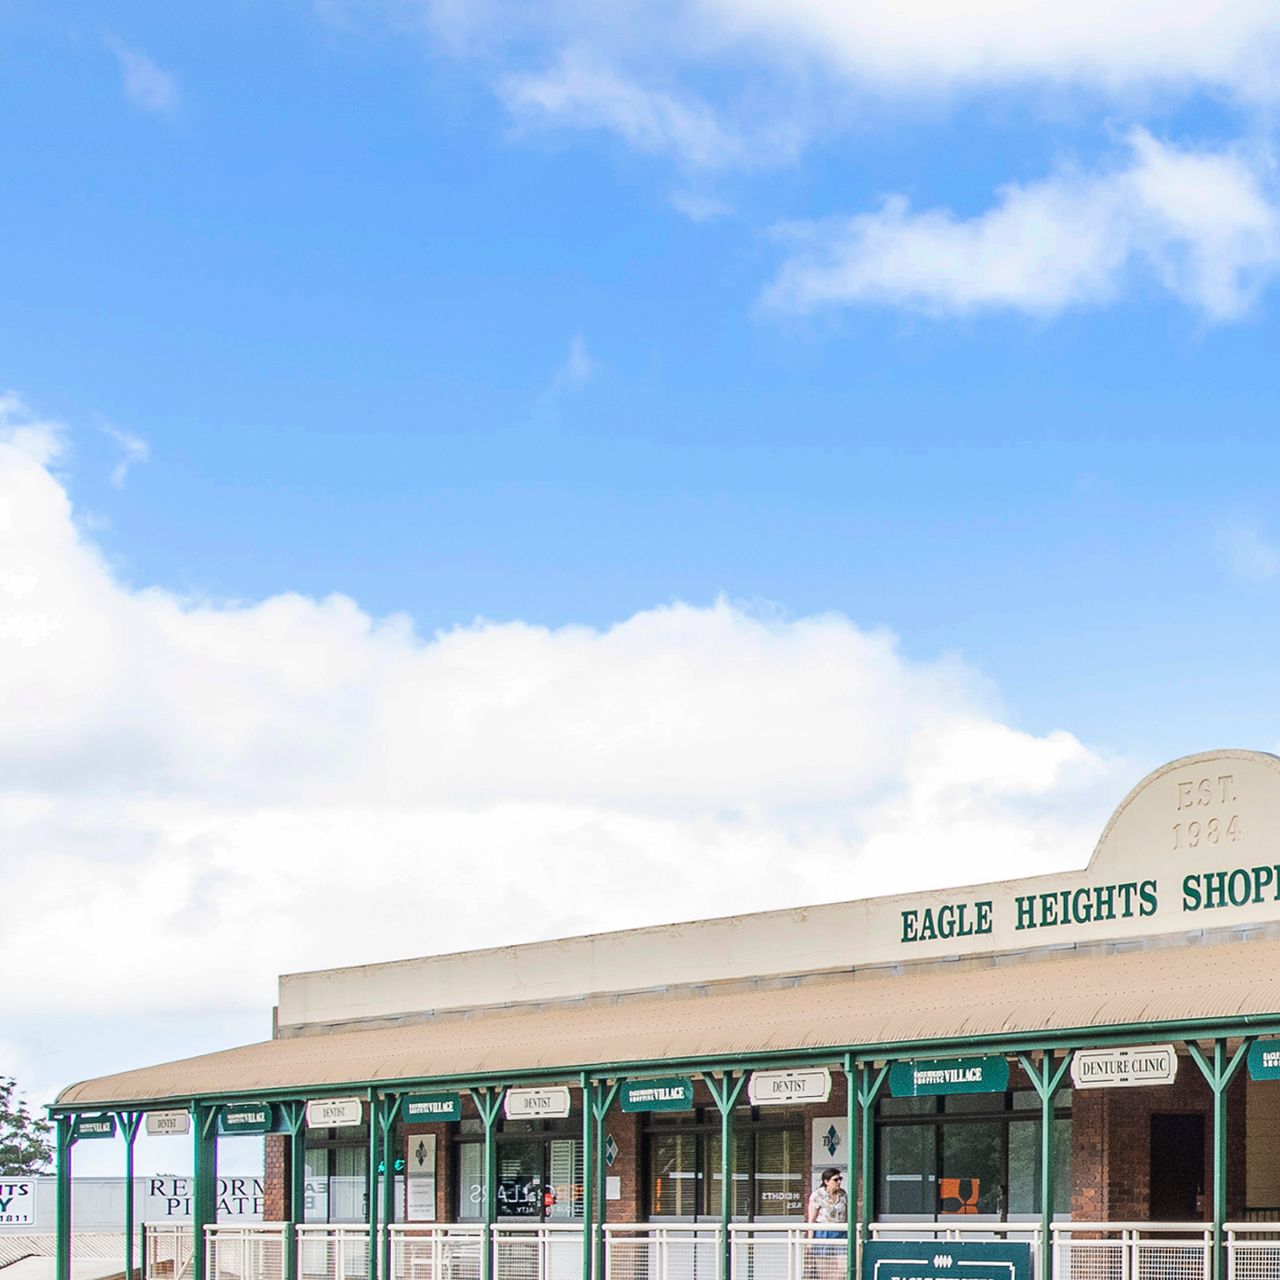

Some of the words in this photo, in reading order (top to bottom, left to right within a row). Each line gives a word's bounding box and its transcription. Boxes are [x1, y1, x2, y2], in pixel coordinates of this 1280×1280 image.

[1177, 775, 1237, 812] EST.
[1172, 814, 1242, 851] 1984
[901, 900, 993, 943] EAGLE
[1014, 880, 1158, 931] HEIGHTS
[944, 1067, 983, 1082] VILLAGE
[1082, 1061, 1131, 1077] DENTURE
[1131, 1058, 1168, 1073] CLINIC
[653, 1087, 685, 1101] VILLAGE
[772, 1079, 807, 1094] DENTIST
[524, 1096, 551, 1109] DENTIST
